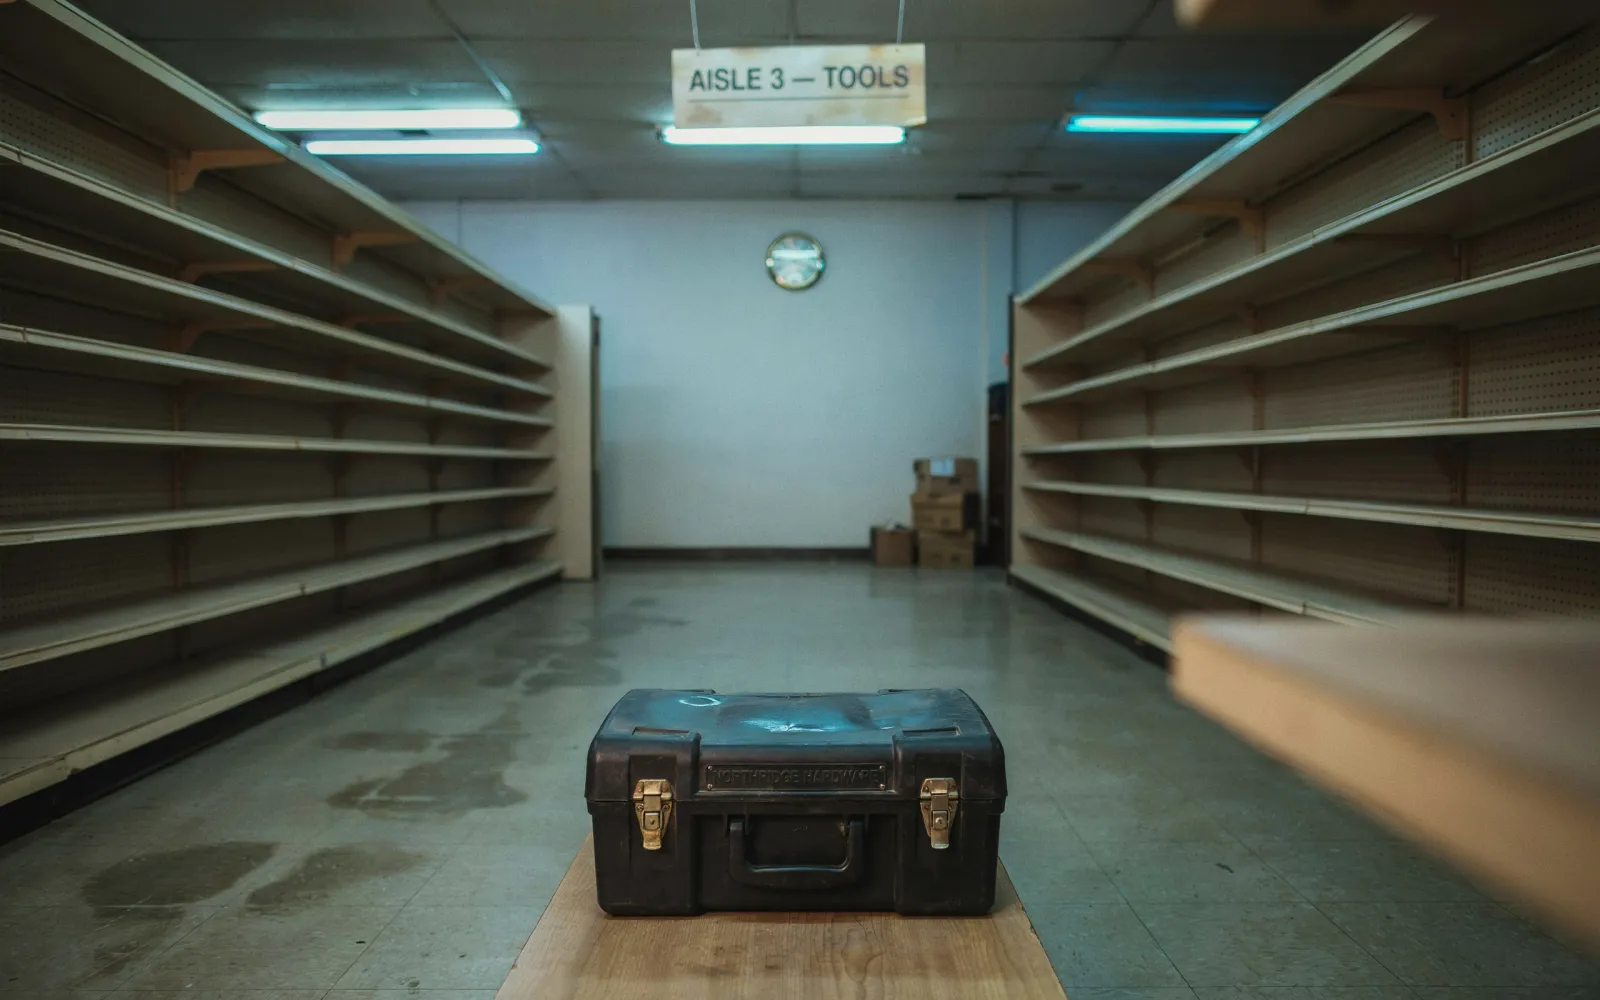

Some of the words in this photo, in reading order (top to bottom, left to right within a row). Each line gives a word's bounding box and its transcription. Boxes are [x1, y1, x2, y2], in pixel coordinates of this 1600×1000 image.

[689, 68, 762, 91] AISLE
[770, 67, 785, 90] 3
[823, 65, 909, 90] TOOLS
[803, 769, 879, 784] HARDWARE
